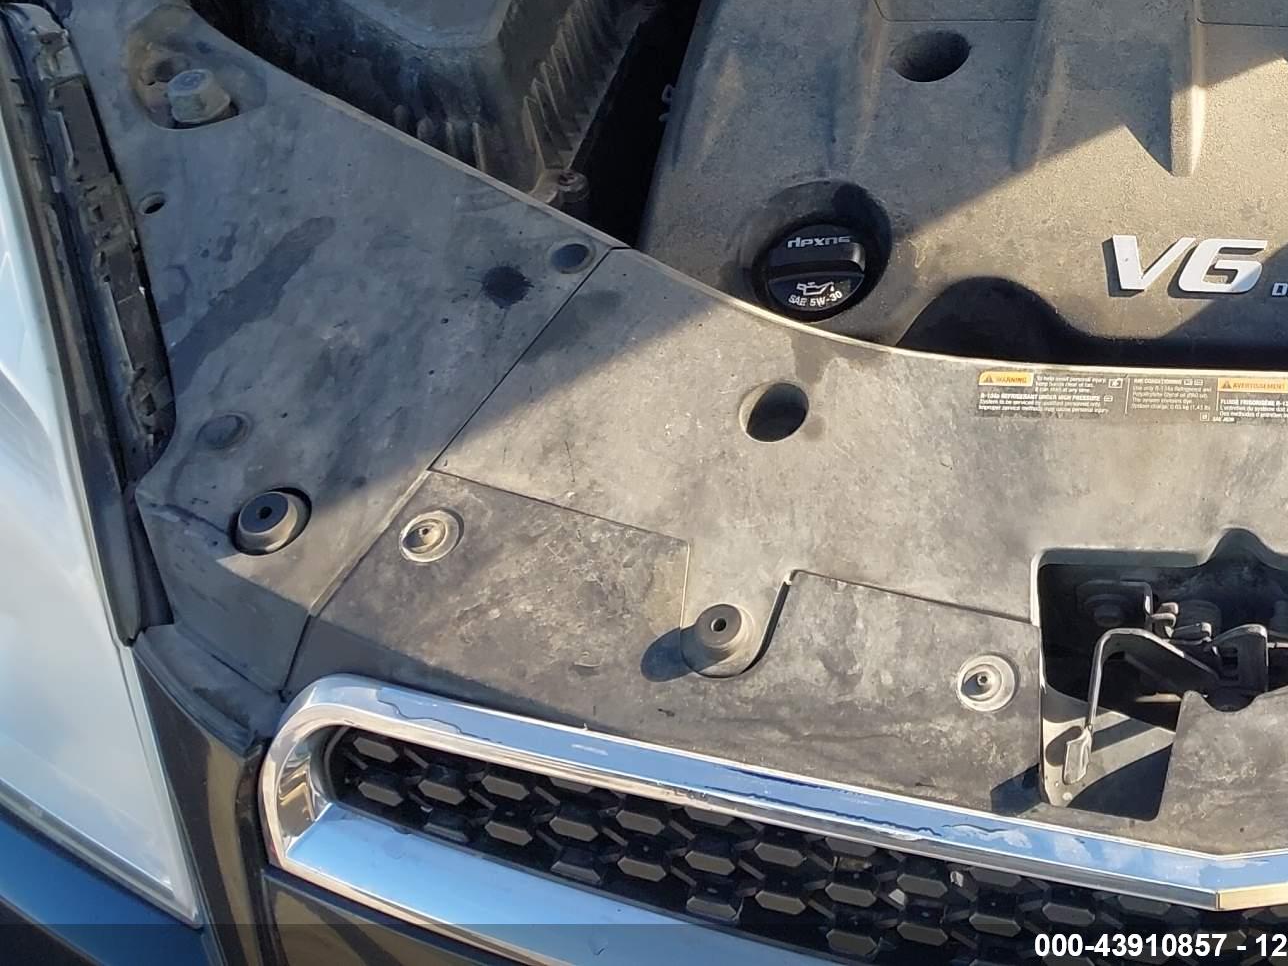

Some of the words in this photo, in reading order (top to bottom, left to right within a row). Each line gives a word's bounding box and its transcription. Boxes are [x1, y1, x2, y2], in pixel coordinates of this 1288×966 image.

[1111, 234, 1269, 294] V6
[788, 294, 808, 307] SAE
[809, 290, 843, 307] 5W-30
